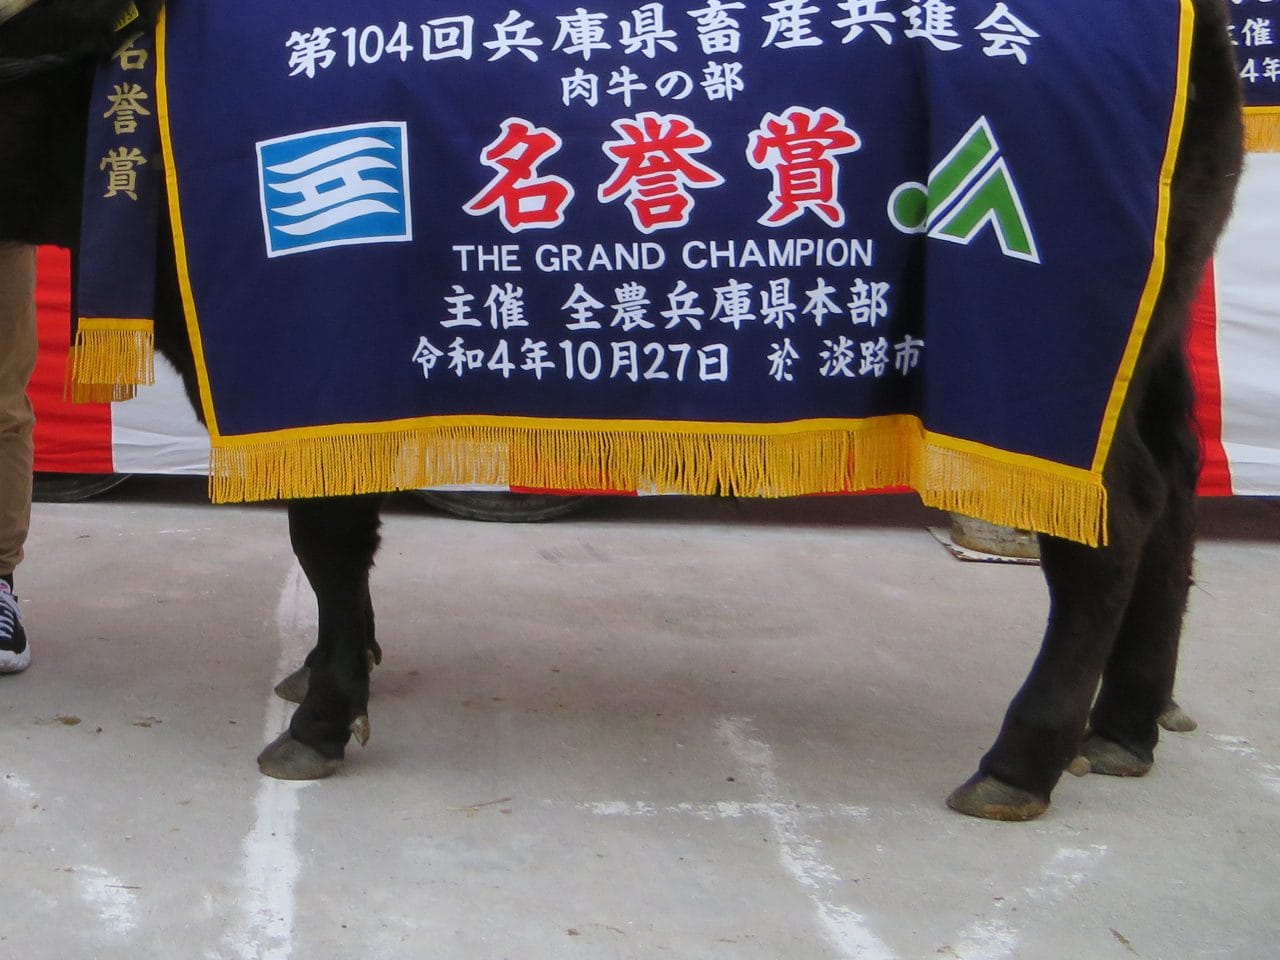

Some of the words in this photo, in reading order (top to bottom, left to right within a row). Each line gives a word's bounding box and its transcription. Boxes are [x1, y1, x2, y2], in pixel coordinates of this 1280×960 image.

[560, 62, 746, 107] 肉牛の部
[462, 105, 862, 234] 名誉賞
[452, 244, 521, 272] THE
[535, 242, 666, 272] GRAND
[681, 238, 874, 269] CHAMPION
[439, 282, 530, 330] 主催
[560, 276, 891, 331] 全農兵庫県本部
[411, 334, 729, 381] 令和4年10月27日
[767, 342, 801, 381] 於
